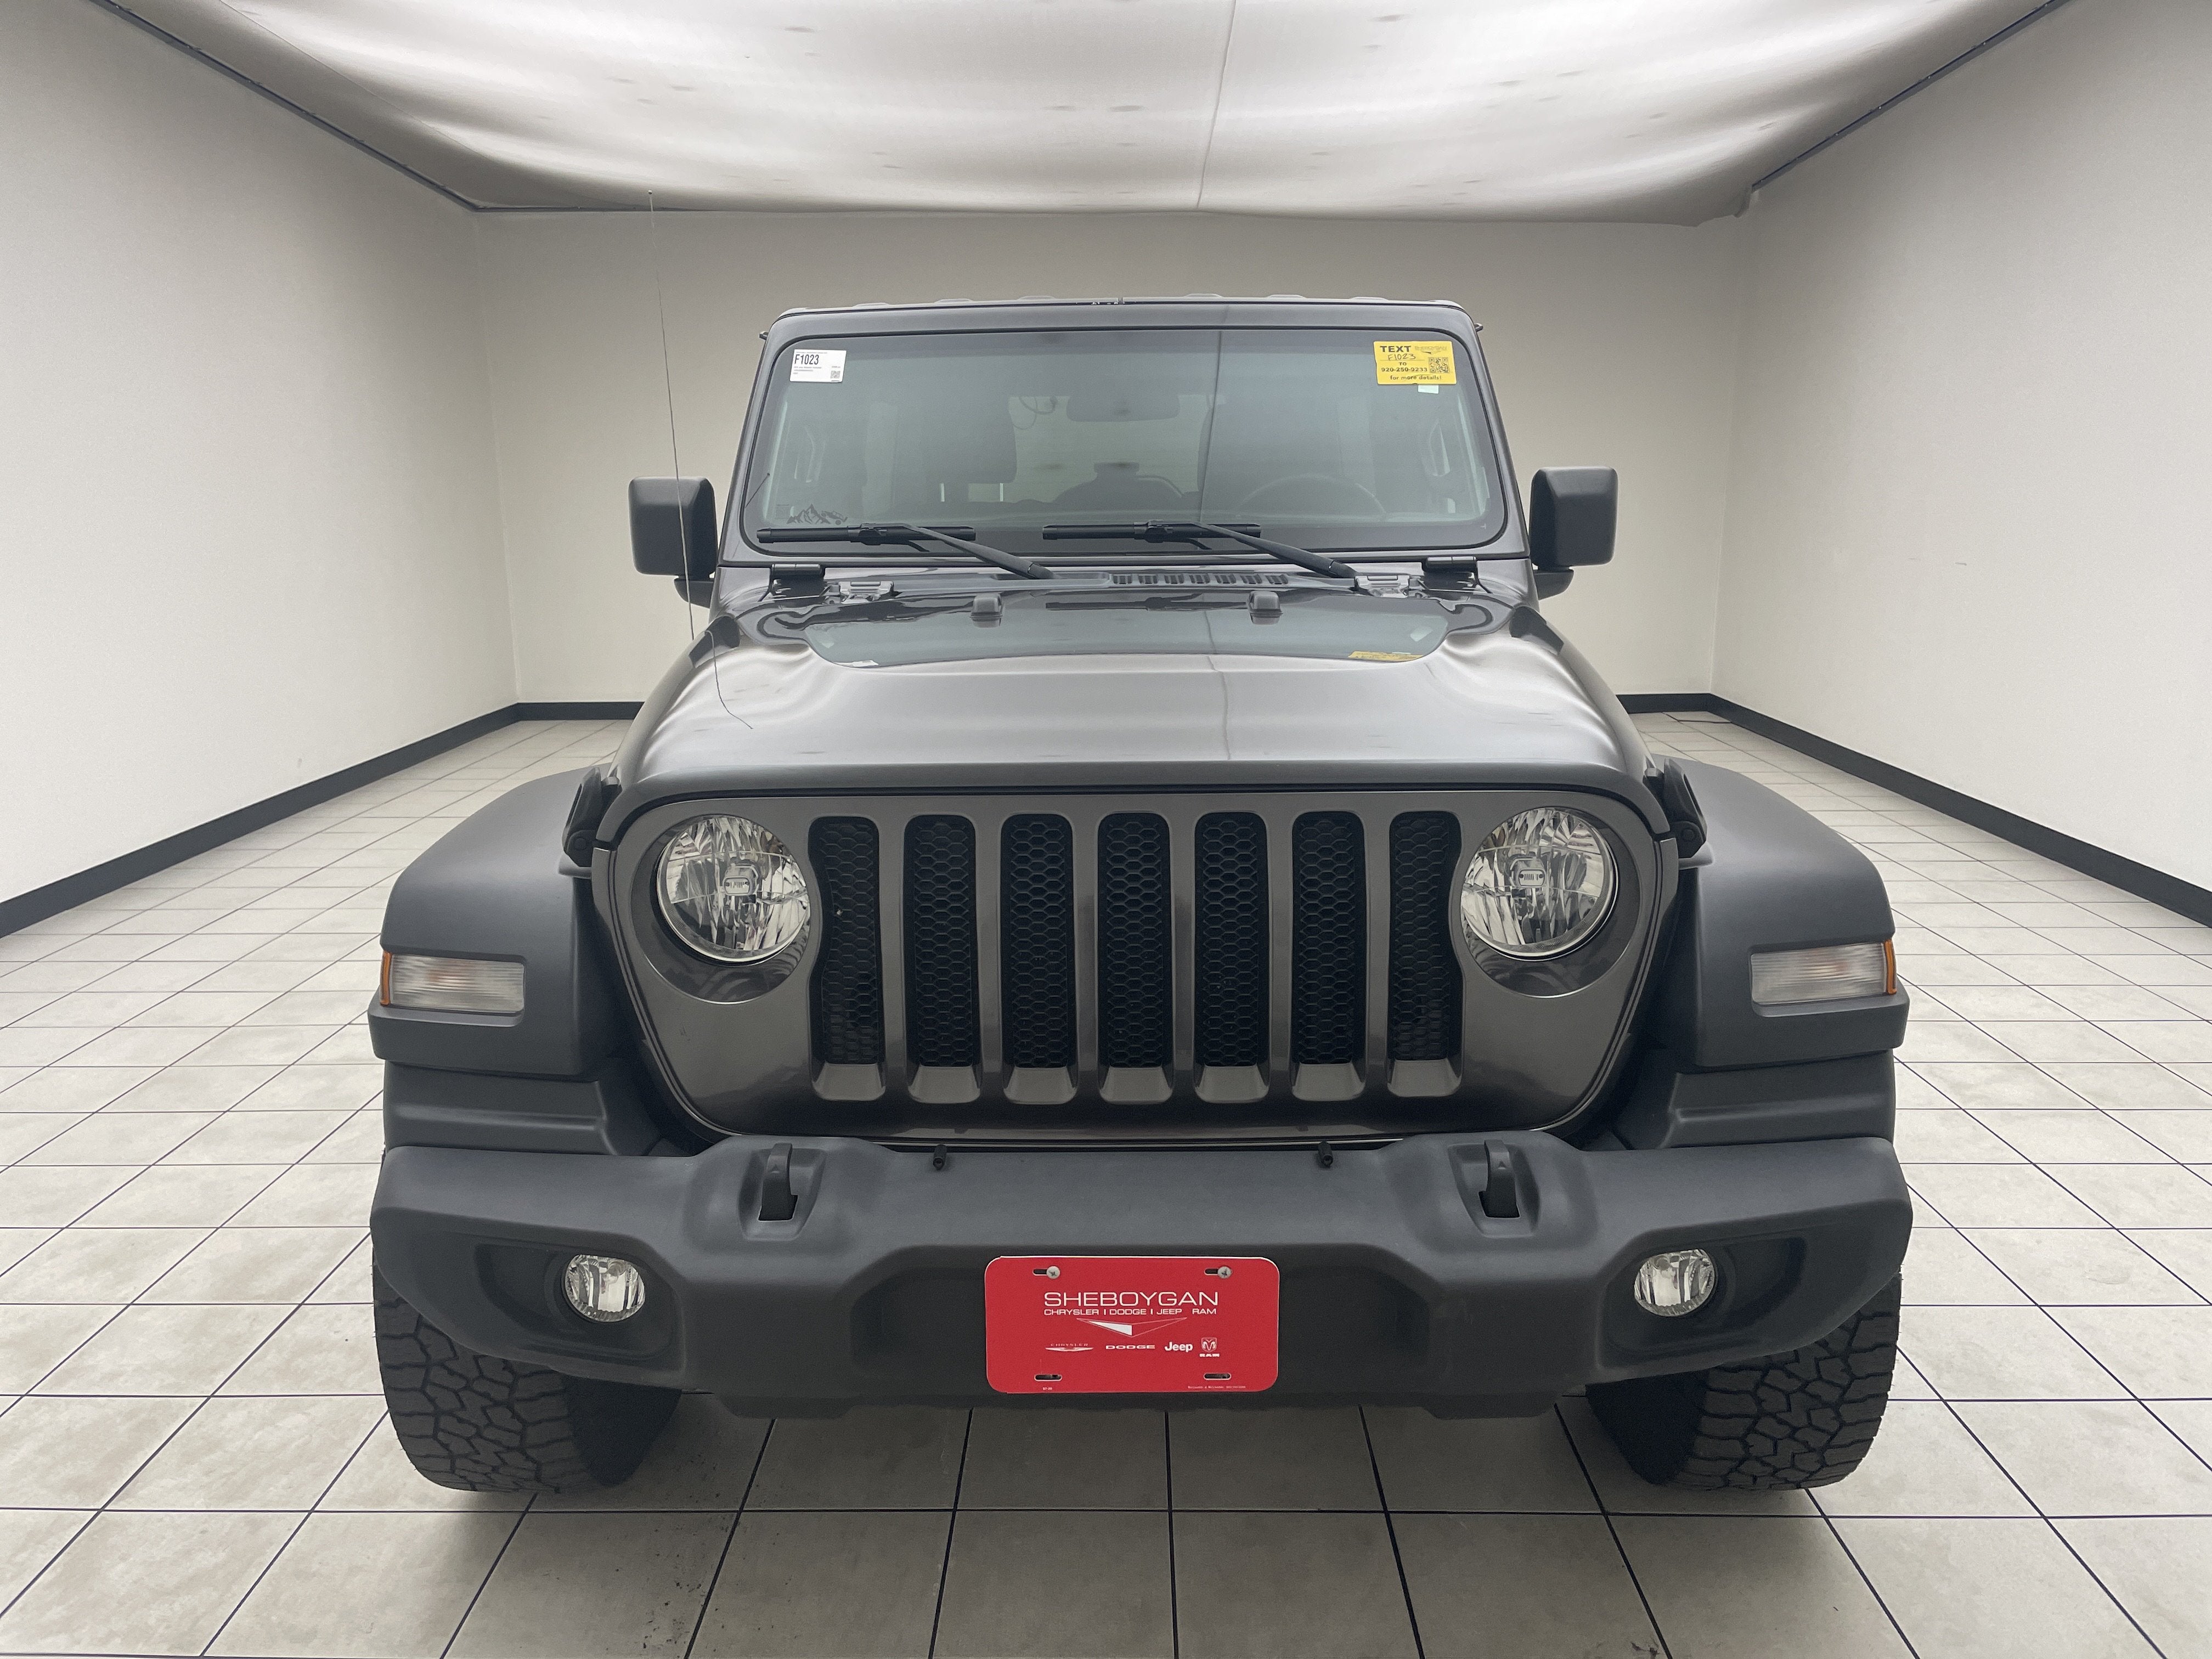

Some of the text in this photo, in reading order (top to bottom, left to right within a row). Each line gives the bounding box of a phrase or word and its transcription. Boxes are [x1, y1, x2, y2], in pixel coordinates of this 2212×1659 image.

[794, 354, 819, 365] F1023
[1387, 353, 1416, 361] F1023
[1044, 1291, 1218, 1307] SHEBOYGAN
[1164, 1341, 1193, 1352] Jeep
